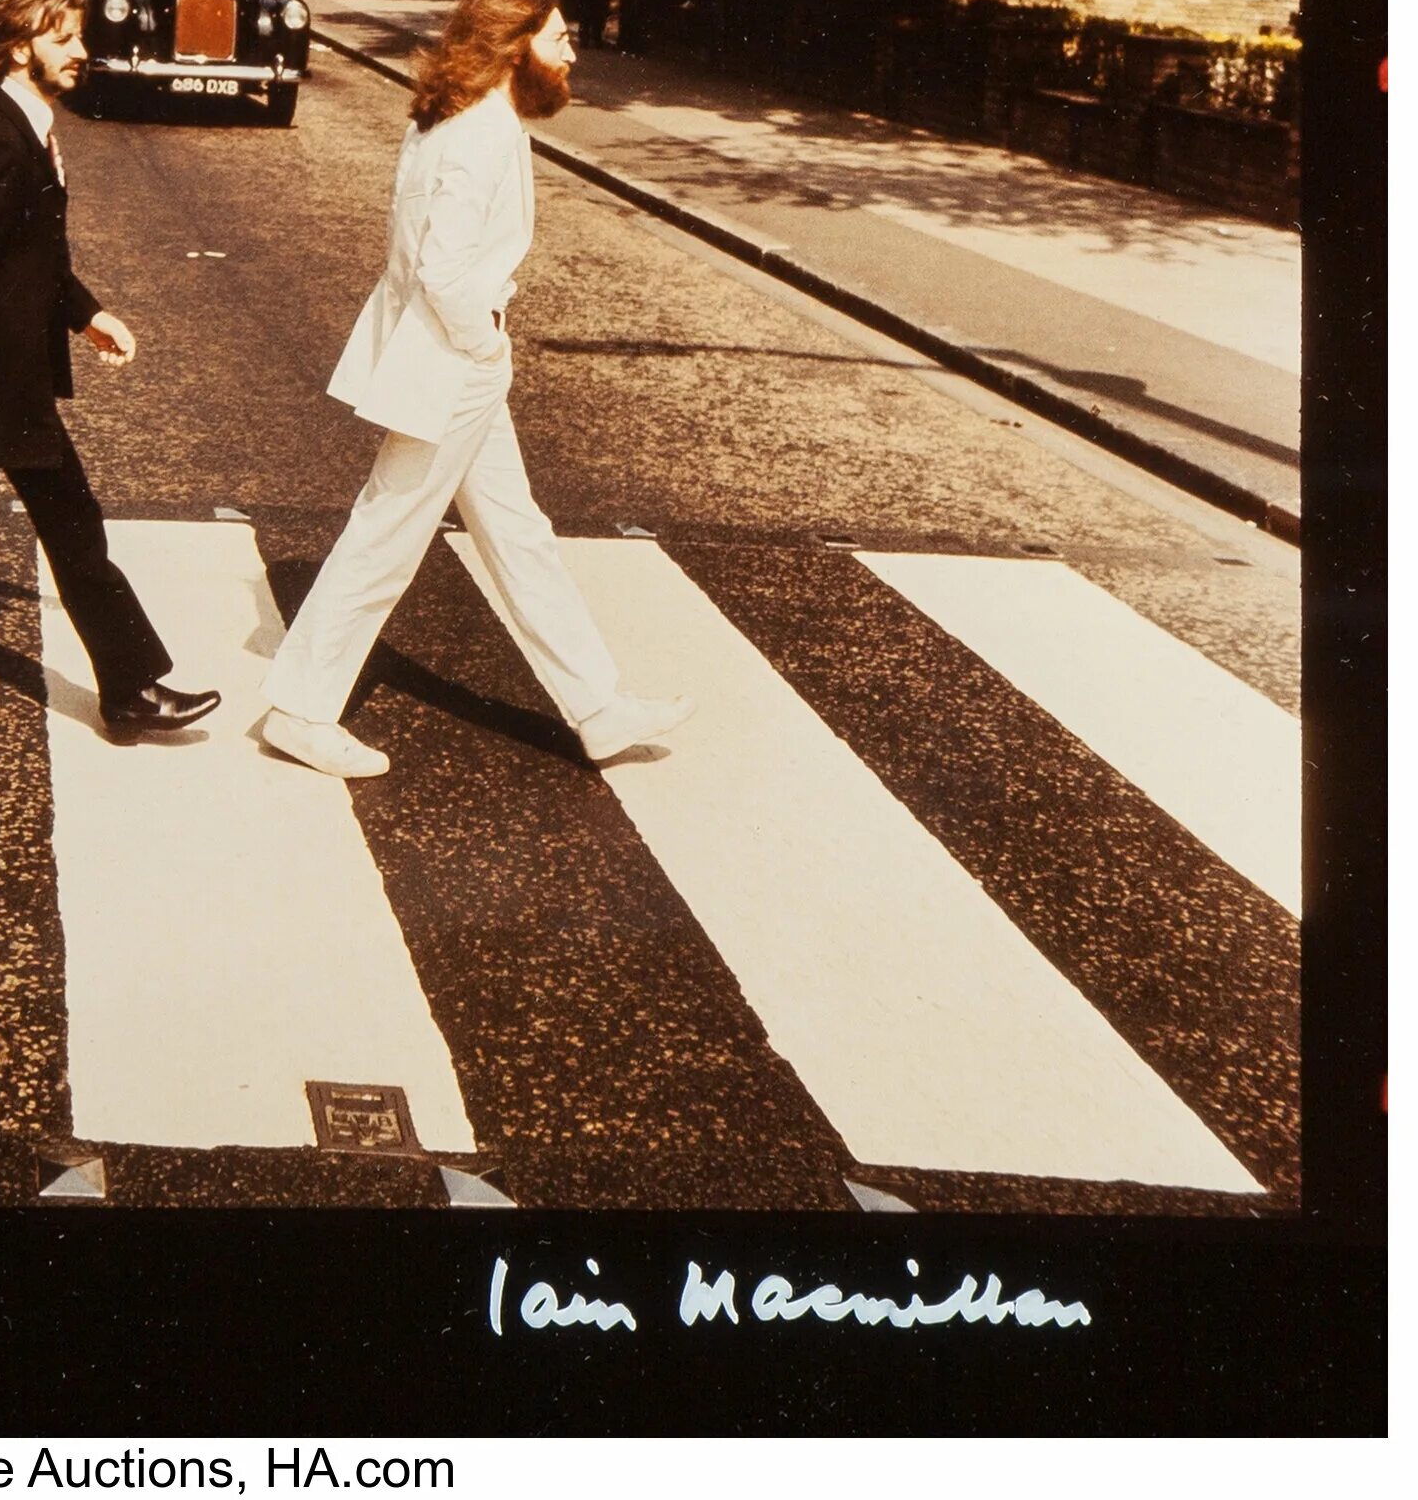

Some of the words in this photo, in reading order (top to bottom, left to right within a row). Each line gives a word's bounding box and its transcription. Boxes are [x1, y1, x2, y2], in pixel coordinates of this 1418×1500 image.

[206, 79, 239, 95] DXB
[490, 1257, 637, 1336] Iain
[680, 1258, 1092, 1329] Macmillan
